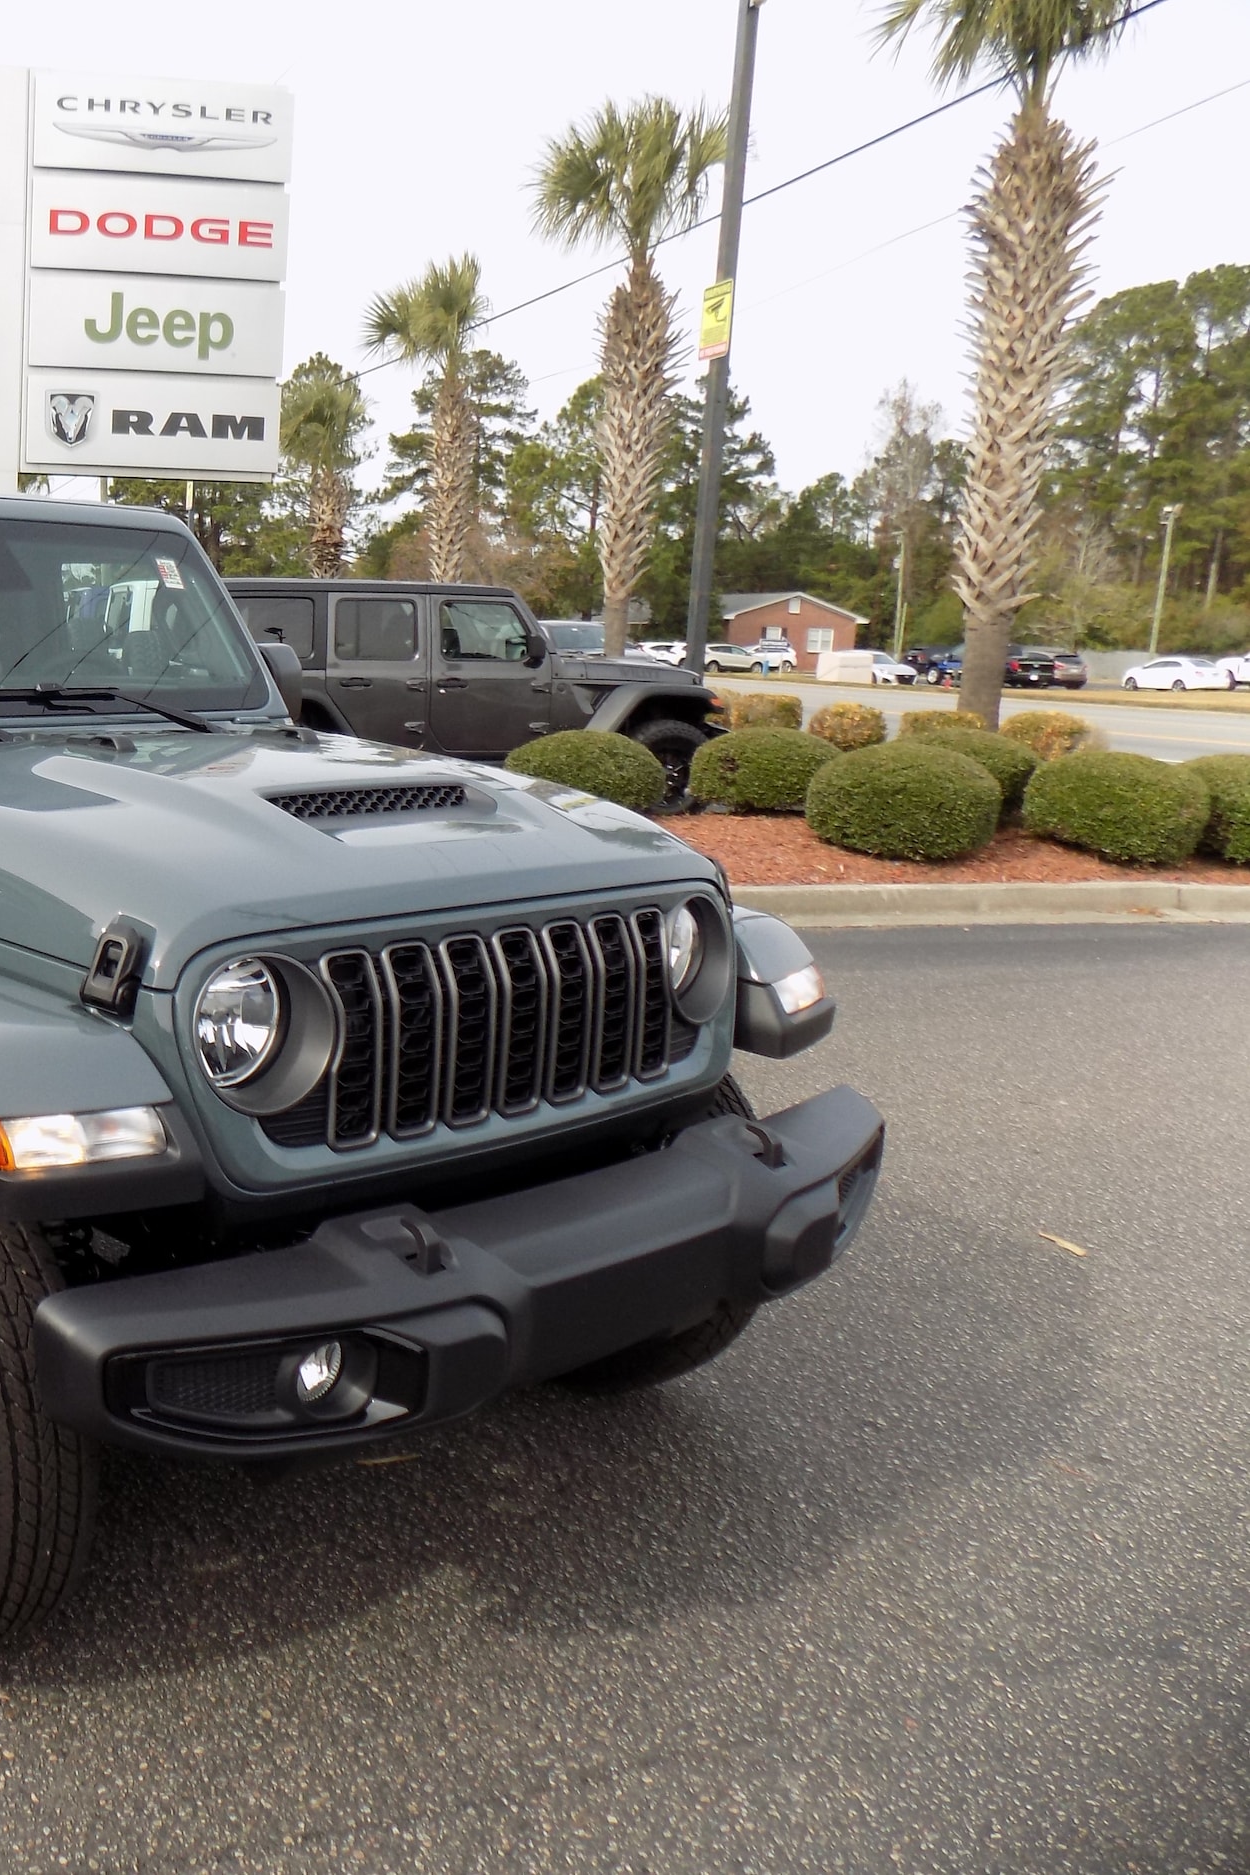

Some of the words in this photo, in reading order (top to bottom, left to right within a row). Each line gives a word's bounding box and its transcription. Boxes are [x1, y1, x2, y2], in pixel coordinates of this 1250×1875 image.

[56, 96, 273, 126] CHRYSLER
[49, 209, 273, 249] DODGE
[84, 291, 235, 361] Jeep
[111, 408, 265, 441] RAM
